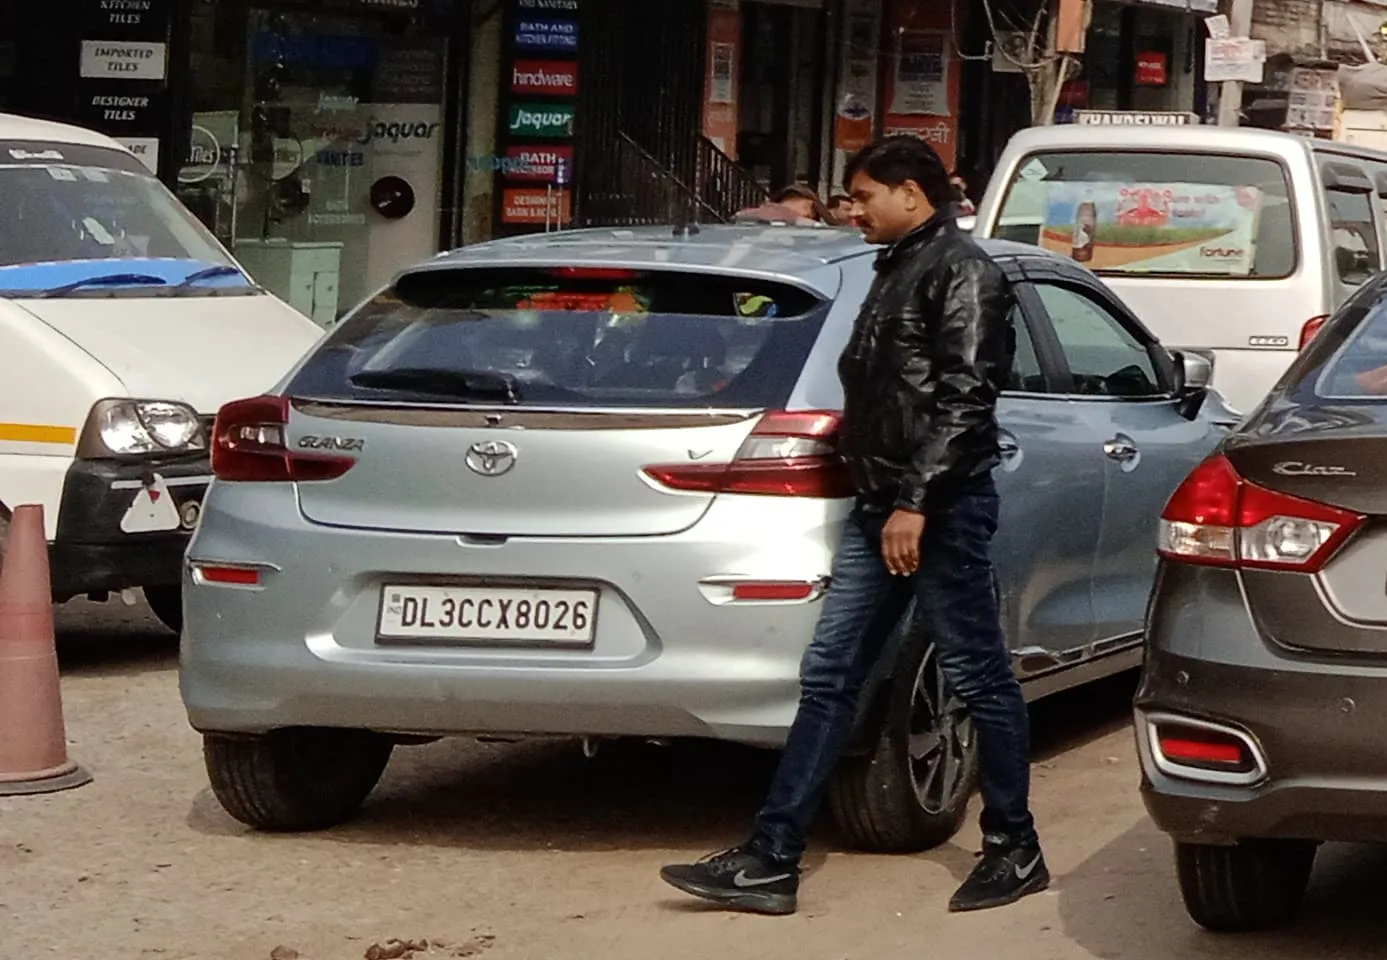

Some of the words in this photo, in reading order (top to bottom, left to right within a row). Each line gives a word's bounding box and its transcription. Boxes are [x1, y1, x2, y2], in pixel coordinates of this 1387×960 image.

[109, 12, 141, 24] TILES
[94, 47, 154, 59] IMPORTED
[107, 61, 139, 73] TILES
[512, 67, 574, 87] hindware
[91, 95, 149, 108] DESIGNER
[103, 109, 136, 121] TILES
[298, 434, 365, 453] GLANZA
[400, 596, 589, 631] DL3CCX8026
